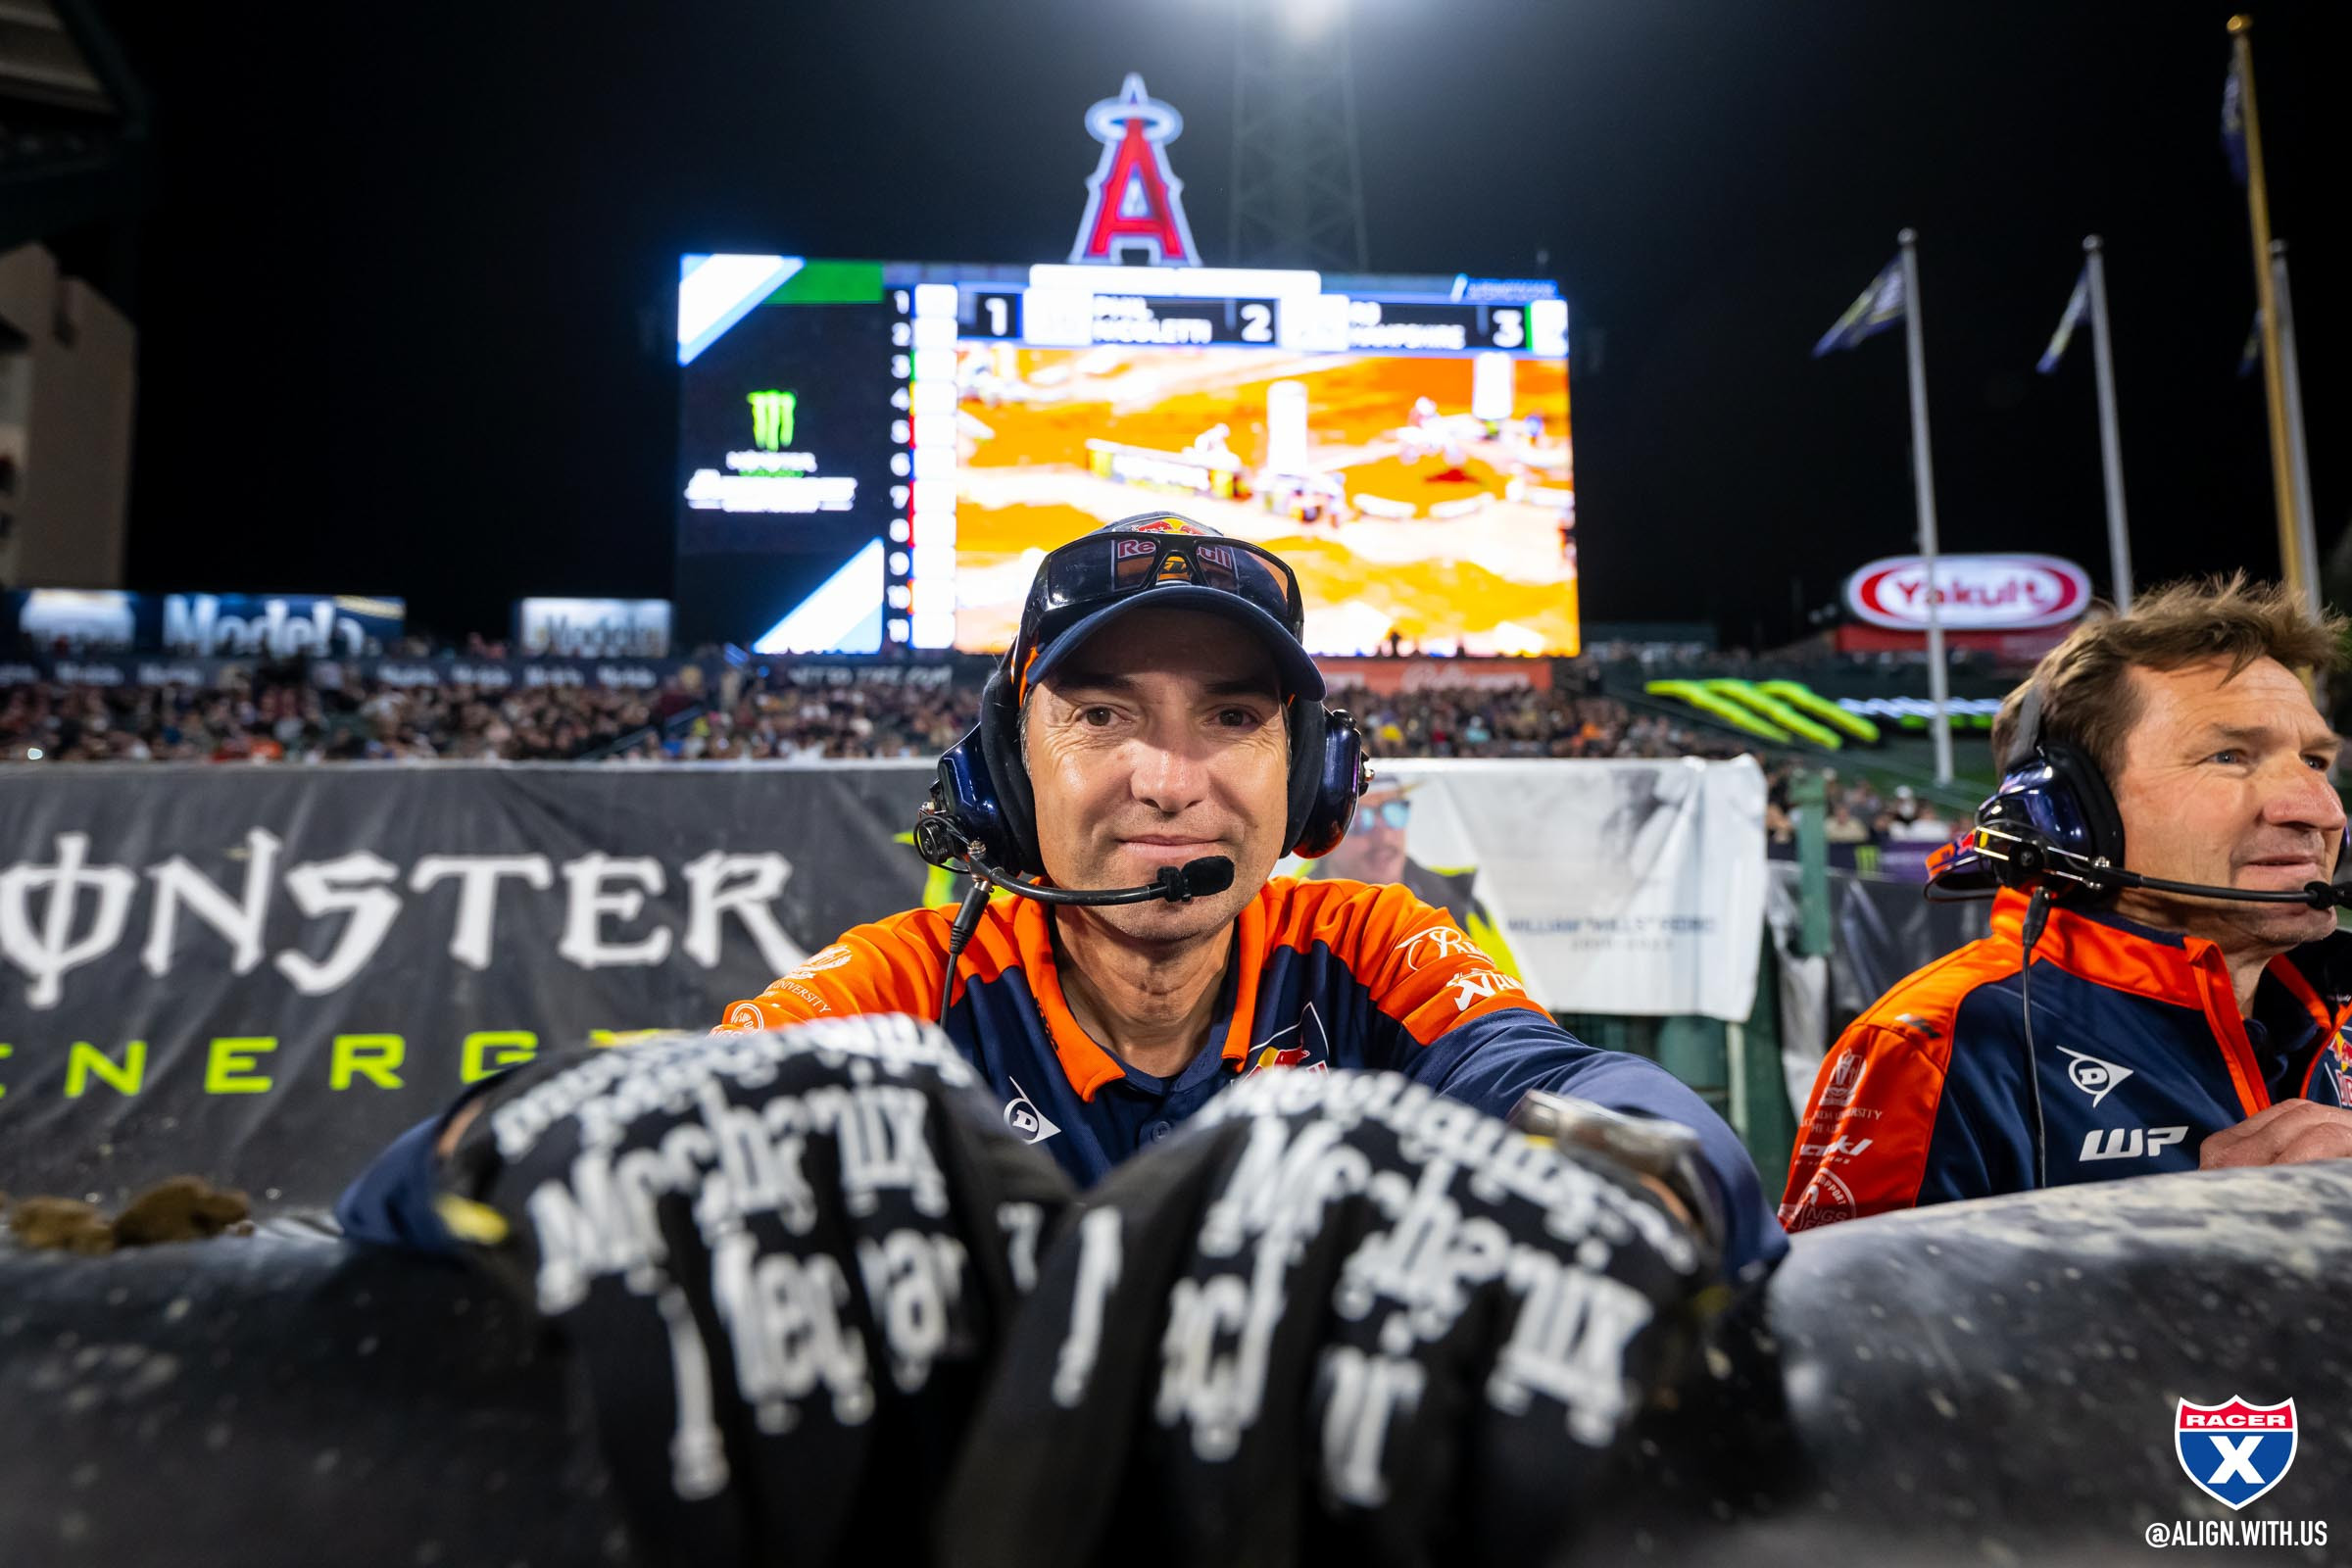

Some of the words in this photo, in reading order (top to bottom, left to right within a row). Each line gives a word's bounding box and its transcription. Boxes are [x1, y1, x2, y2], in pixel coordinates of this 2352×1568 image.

[1068, 71, 1202, 268] A
[985, 298, 1007, 336] 1
[1240, 304, 1272, 342] 2
[1492, 309, 1524, 348] 3
[1118, 540, 1156, 559] Re
[1196, 546, 1233, 569] ull
[1895, 578, 2047, 609] Yakult
[0, 1029, 662, 1100] NERG
[2079, 1125, 2189, 1162] WP
